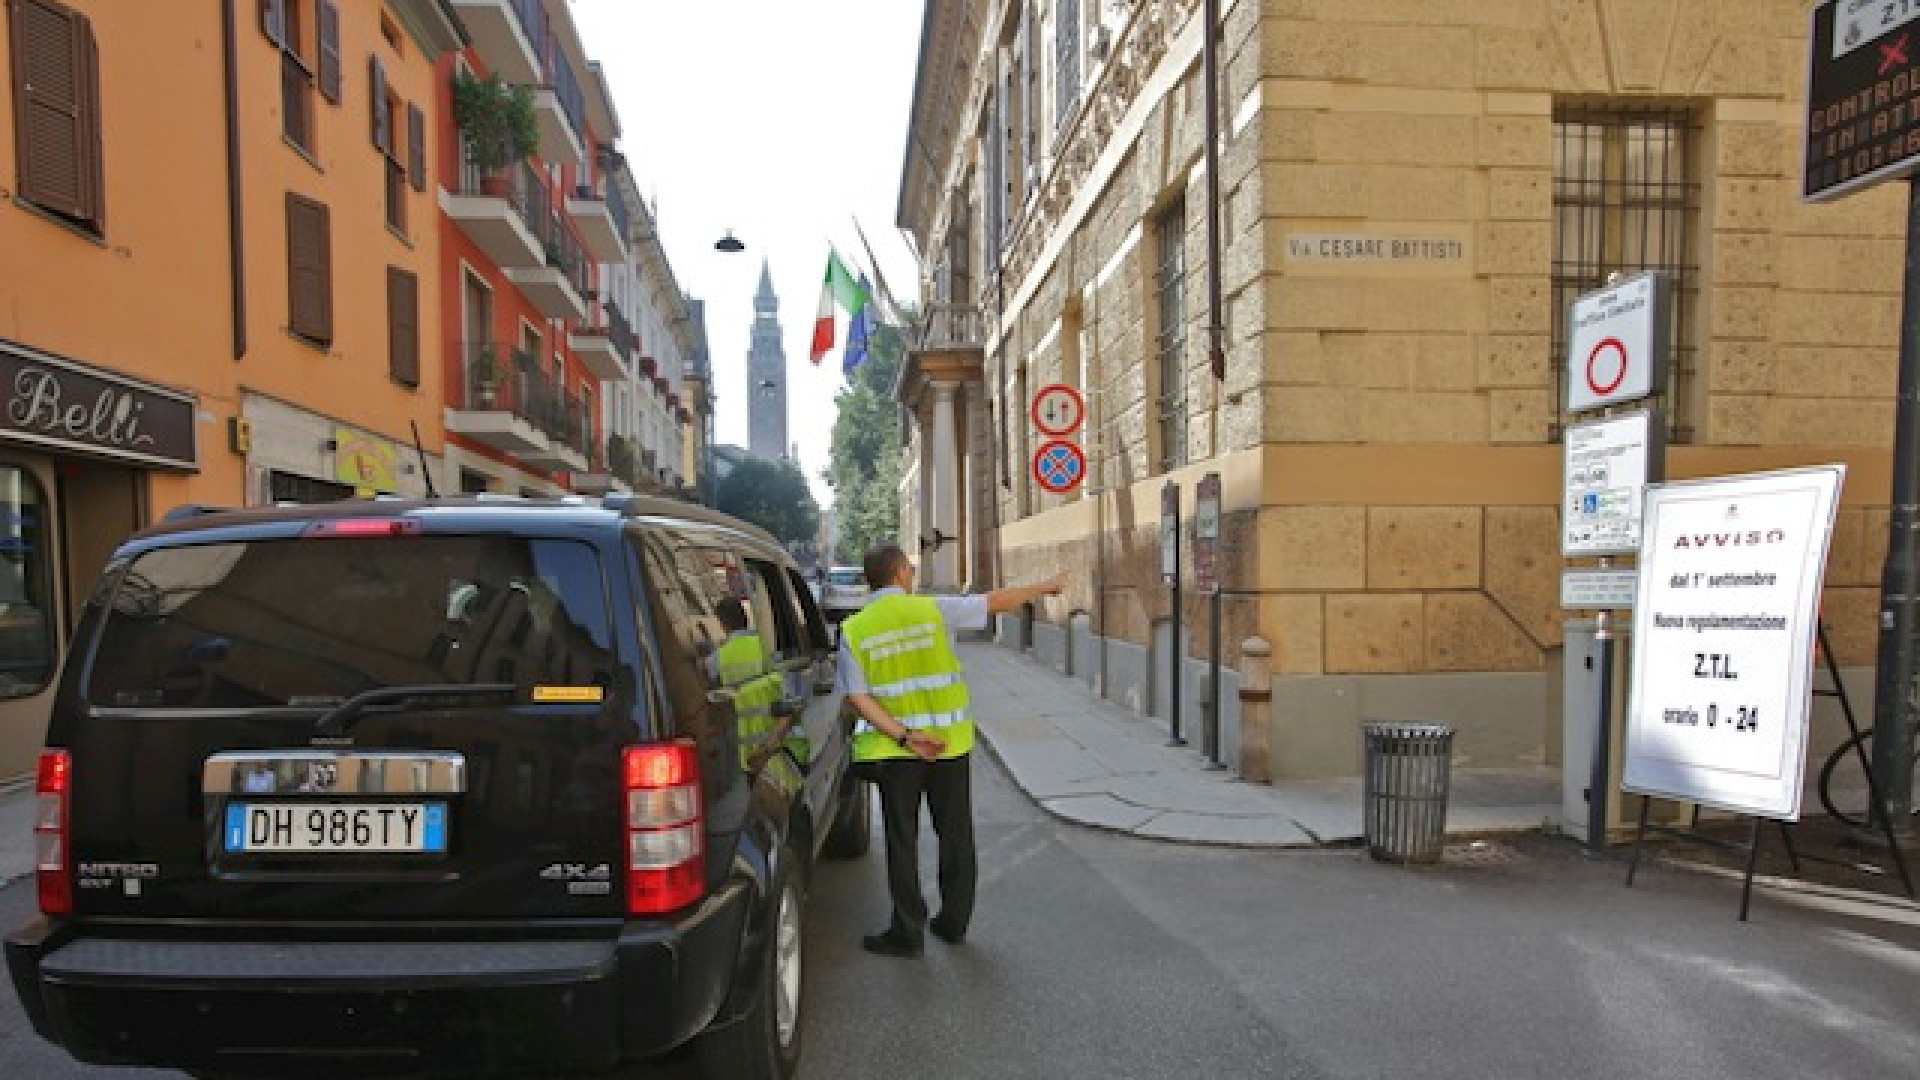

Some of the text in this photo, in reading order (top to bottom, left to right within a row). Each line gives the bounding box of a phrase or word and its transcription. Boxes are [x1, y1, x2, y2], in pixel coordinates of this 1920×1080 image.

[1320, 239, 1384, 258] CESARE
[1392, 239, 1462, 259] BATTISTI
[9, 366, 154, 445] Belli
[1674, 528, 1785, 549] AVVISO
[1669, 573, 1690, 588] dal
[1707, 571, 1777, 588] settembre
[1653, 611, 1788, 633] Nuova regolamentazione
[1662, 705, 1699, 726] orario
[1706, 702, 1718, 729] 0
[1736, 705, 1758, 732] 24
[251, 808, 419, 847] DH 986TY
[79, 863, 159, 877] NITRO
